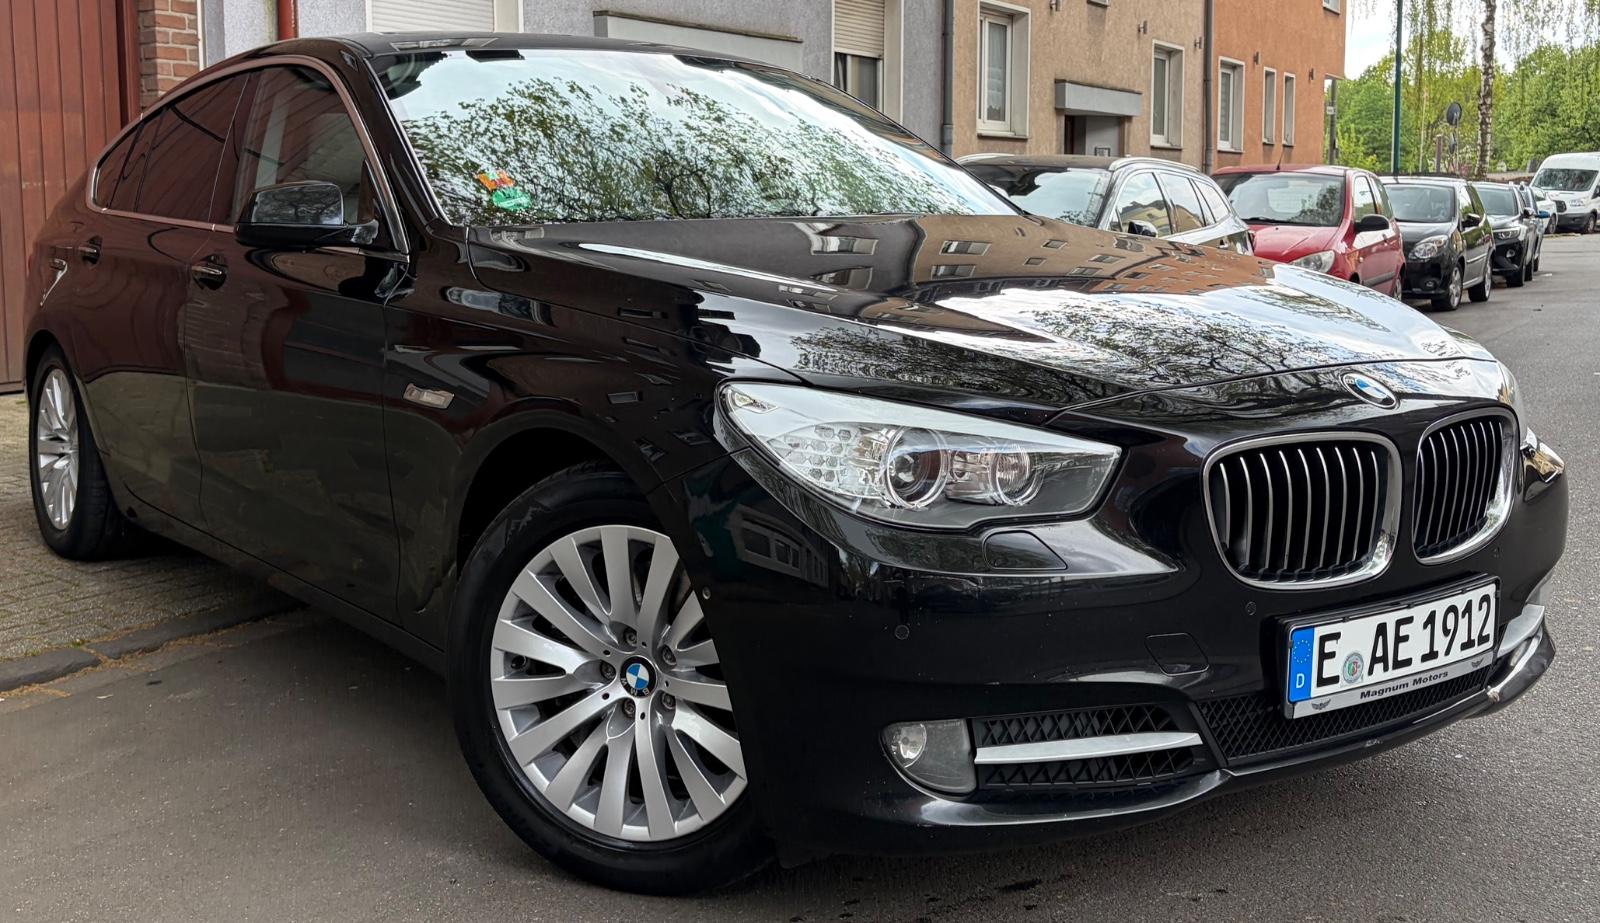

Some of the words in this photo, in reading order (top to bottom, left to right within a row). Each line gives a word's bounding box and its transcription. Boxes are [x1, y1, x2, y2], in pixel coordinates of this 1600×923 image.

[1316, 632, 1341, 687] E
[1296, 673, 1305, 689] D
[1360, 680, 1409, 700] Magnum
[1412, 671, 1449, 686] Motors
